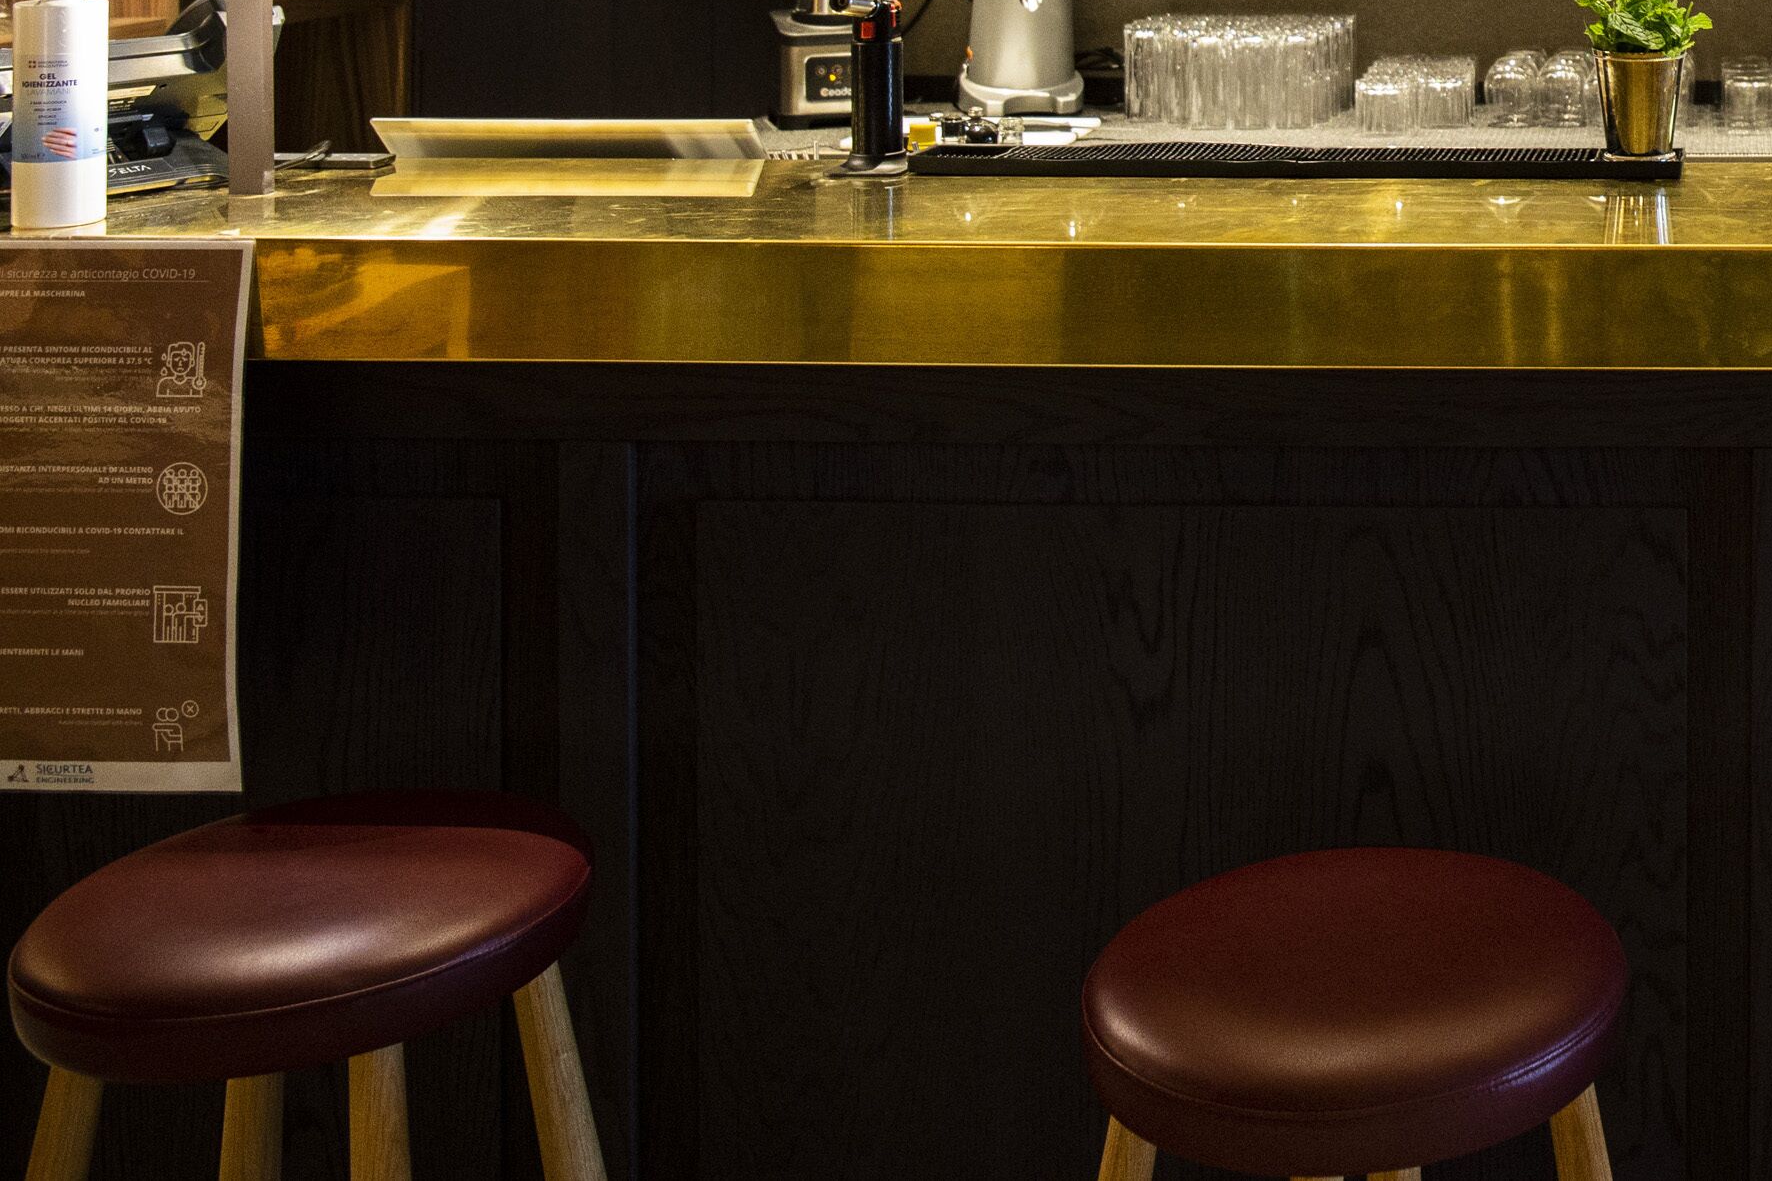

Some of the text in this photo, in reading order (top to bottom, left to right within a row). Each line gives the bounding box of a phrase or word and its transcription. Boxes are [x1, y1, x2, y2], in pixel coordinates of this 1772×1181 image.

[39, 73, 57, 81] GEL
[21, 80, 78, 89] IGIENIZZANTE
[108, 164, 152, 178] SELTA
[7, 269, 57, 279] sicurezza
[61, 271, 67, 279] e
[70, 269, 140, 281] anticontagio
[142, 268, 196, 279] COVID-19
[0, 290, 85, 298] MPRE LA MASCHERINA
[3, 346, 43, 354] PRESENTA
[45, 346, 79, 354] SINTOMI
[81, 346, 141, 354] RICONDUCIBILI
[29, 357, 72, 365] CORPOREA
[74, 357, 117, 365] SUPERIORE
[0, 405, 20, 413] ESSO
[0, 416, 37, 424] OGGETTI
[119, 465, 154, 474] ALMENO
[111, 477, 123, 485] UN
[126, 477, 153, 485] METRO
[16, 526, 76, 536] RICONDUCIBILI
[85, 526, 122, 536] COVID-19
[123, 526, 175, 536] CONTATTARE
[1, 587, 151, 596] ESSERE UTILIZZATI SOLO DAL PROPRIO
[68, 599, 150, 607] NUCLEO FAMIGLIARE
[61, 648, 84, 656] MANI
[24, 706, 64, 715] ABBRACCI
[72, 706, 103, 715] STRETTE
[116, 706, 142, 715] MANO
[36, 764, 93, 774] SICURTEA
[36, 776, 95, 784] ENGINEERING
